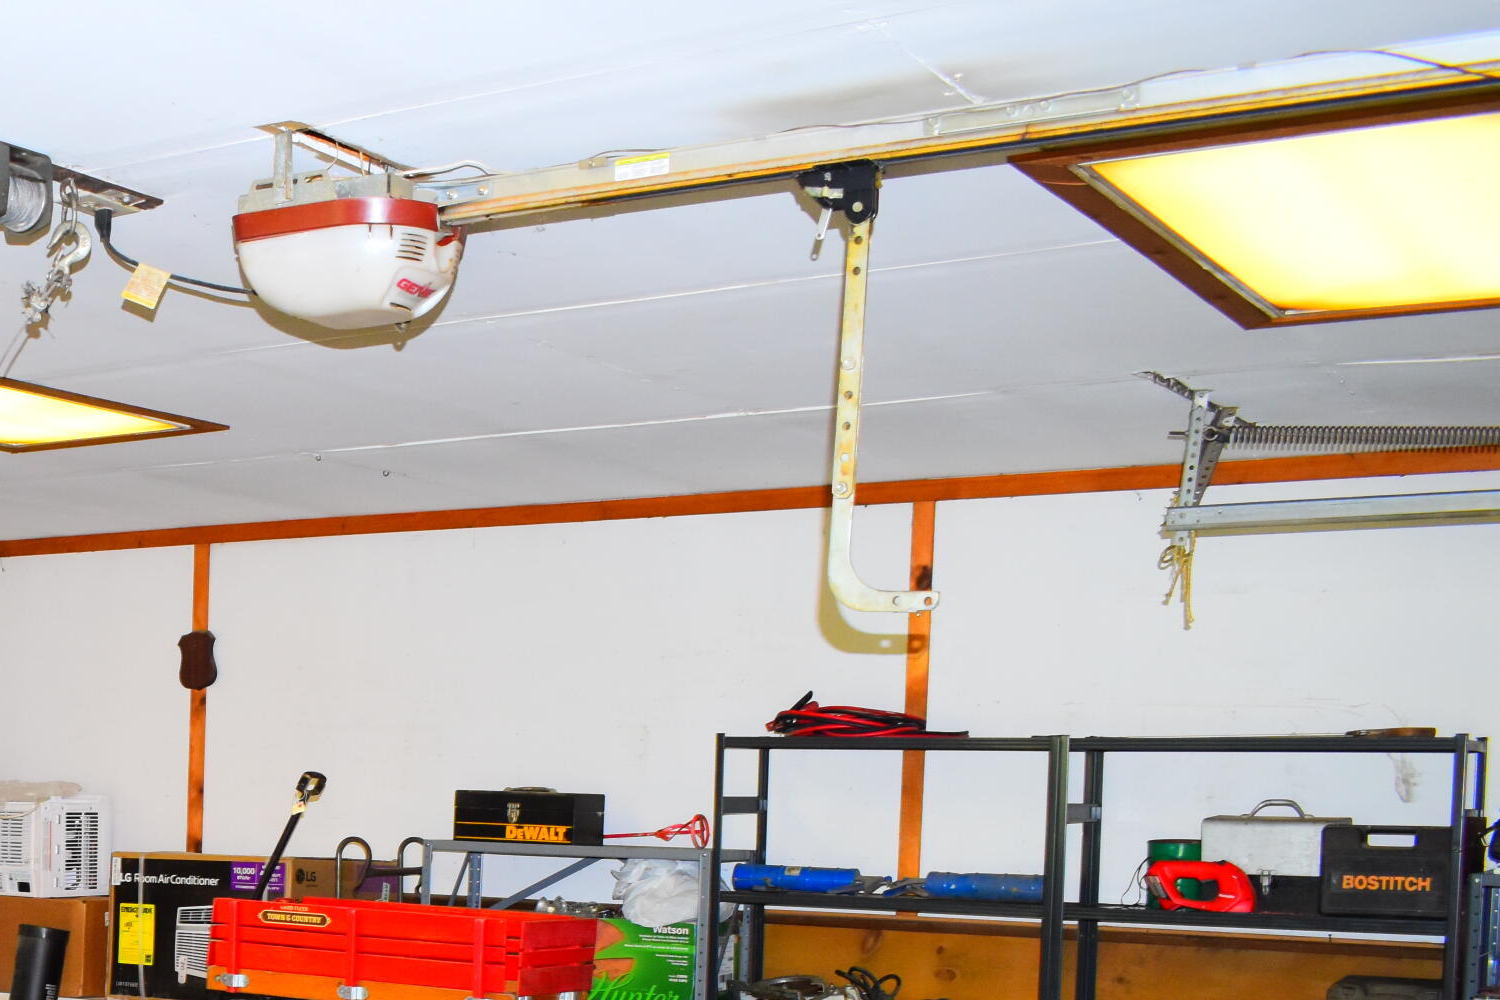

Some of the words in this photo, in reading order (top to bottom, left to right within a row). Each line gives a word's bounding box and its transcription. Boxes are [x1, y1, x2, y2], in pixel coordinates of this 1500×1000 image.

[120, 872, 132, 883] LG
[1342, 875, 1432, 892] BOSTITCH
[653, 926, 689, 935] Watson
